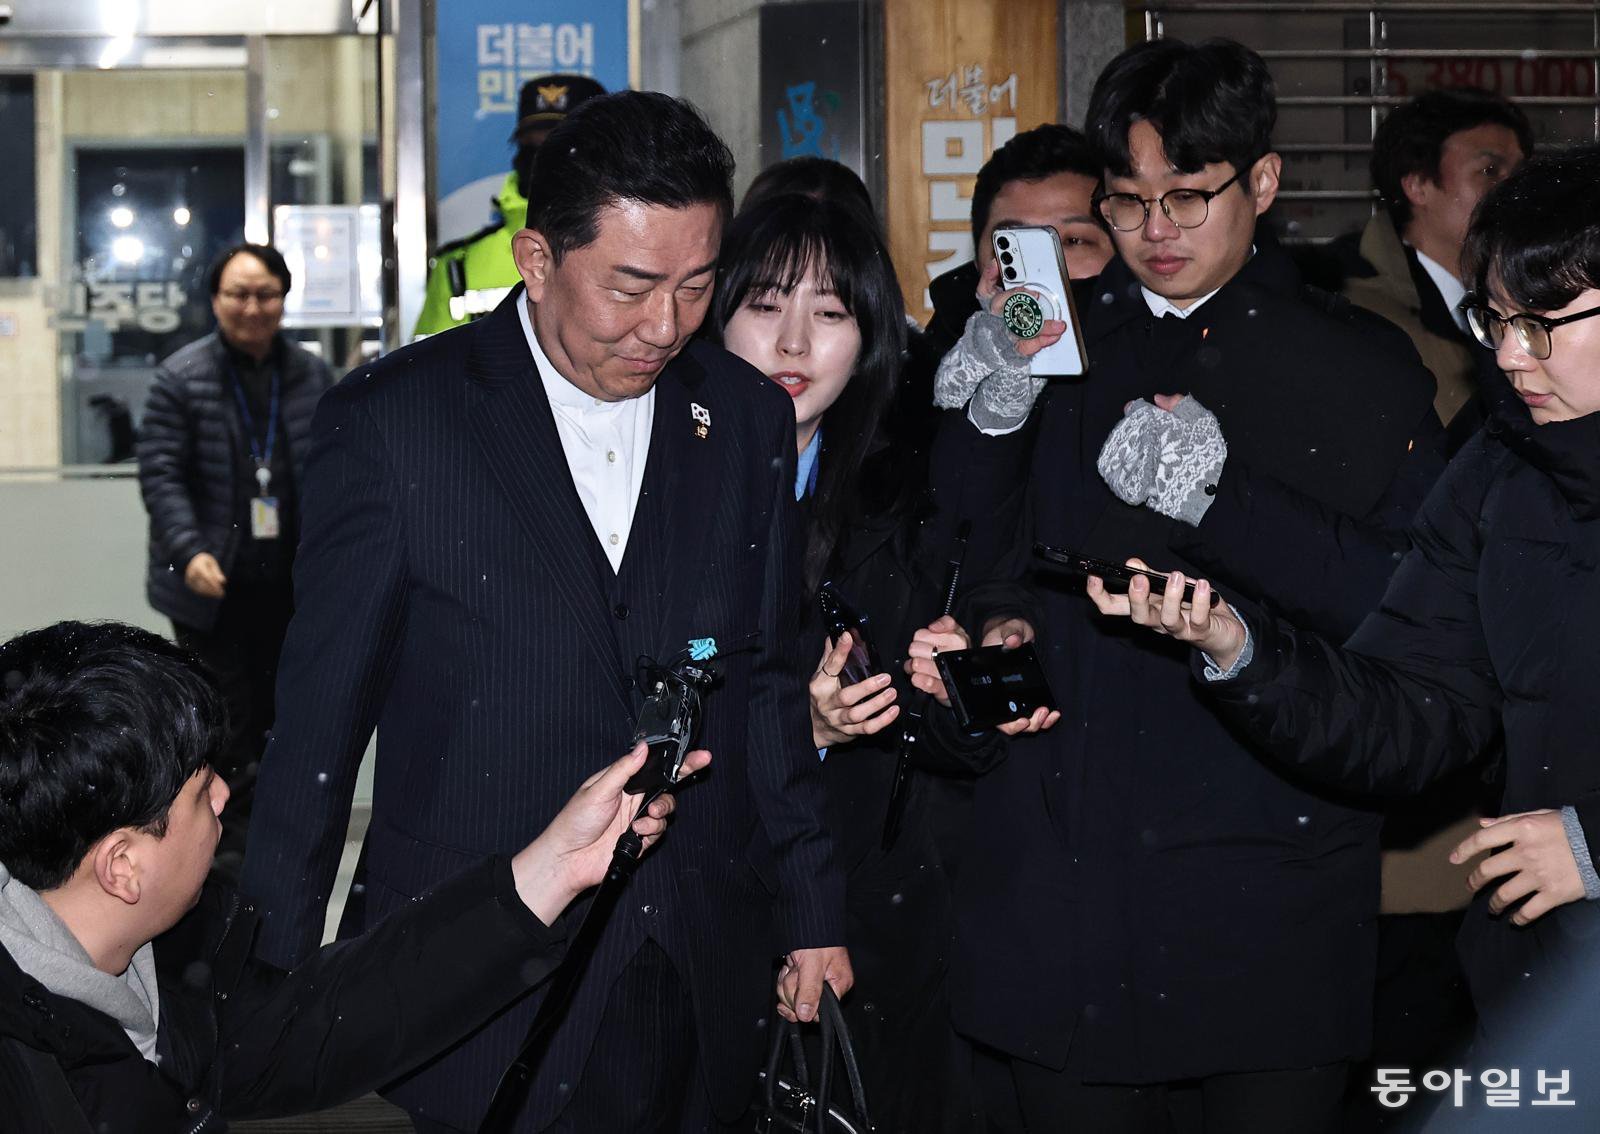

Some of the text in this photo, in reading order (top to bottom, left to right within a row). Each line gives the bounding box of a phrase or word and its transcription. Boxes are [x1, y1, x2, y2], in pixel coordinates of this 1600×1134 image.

[477, 23, 594, 67] 더불어
[924, 64, 1018, 115] 더불어
[1004, 294, 1032, 328] STARBUCKS
[1022, 314, 1042, 337] COFFEE
